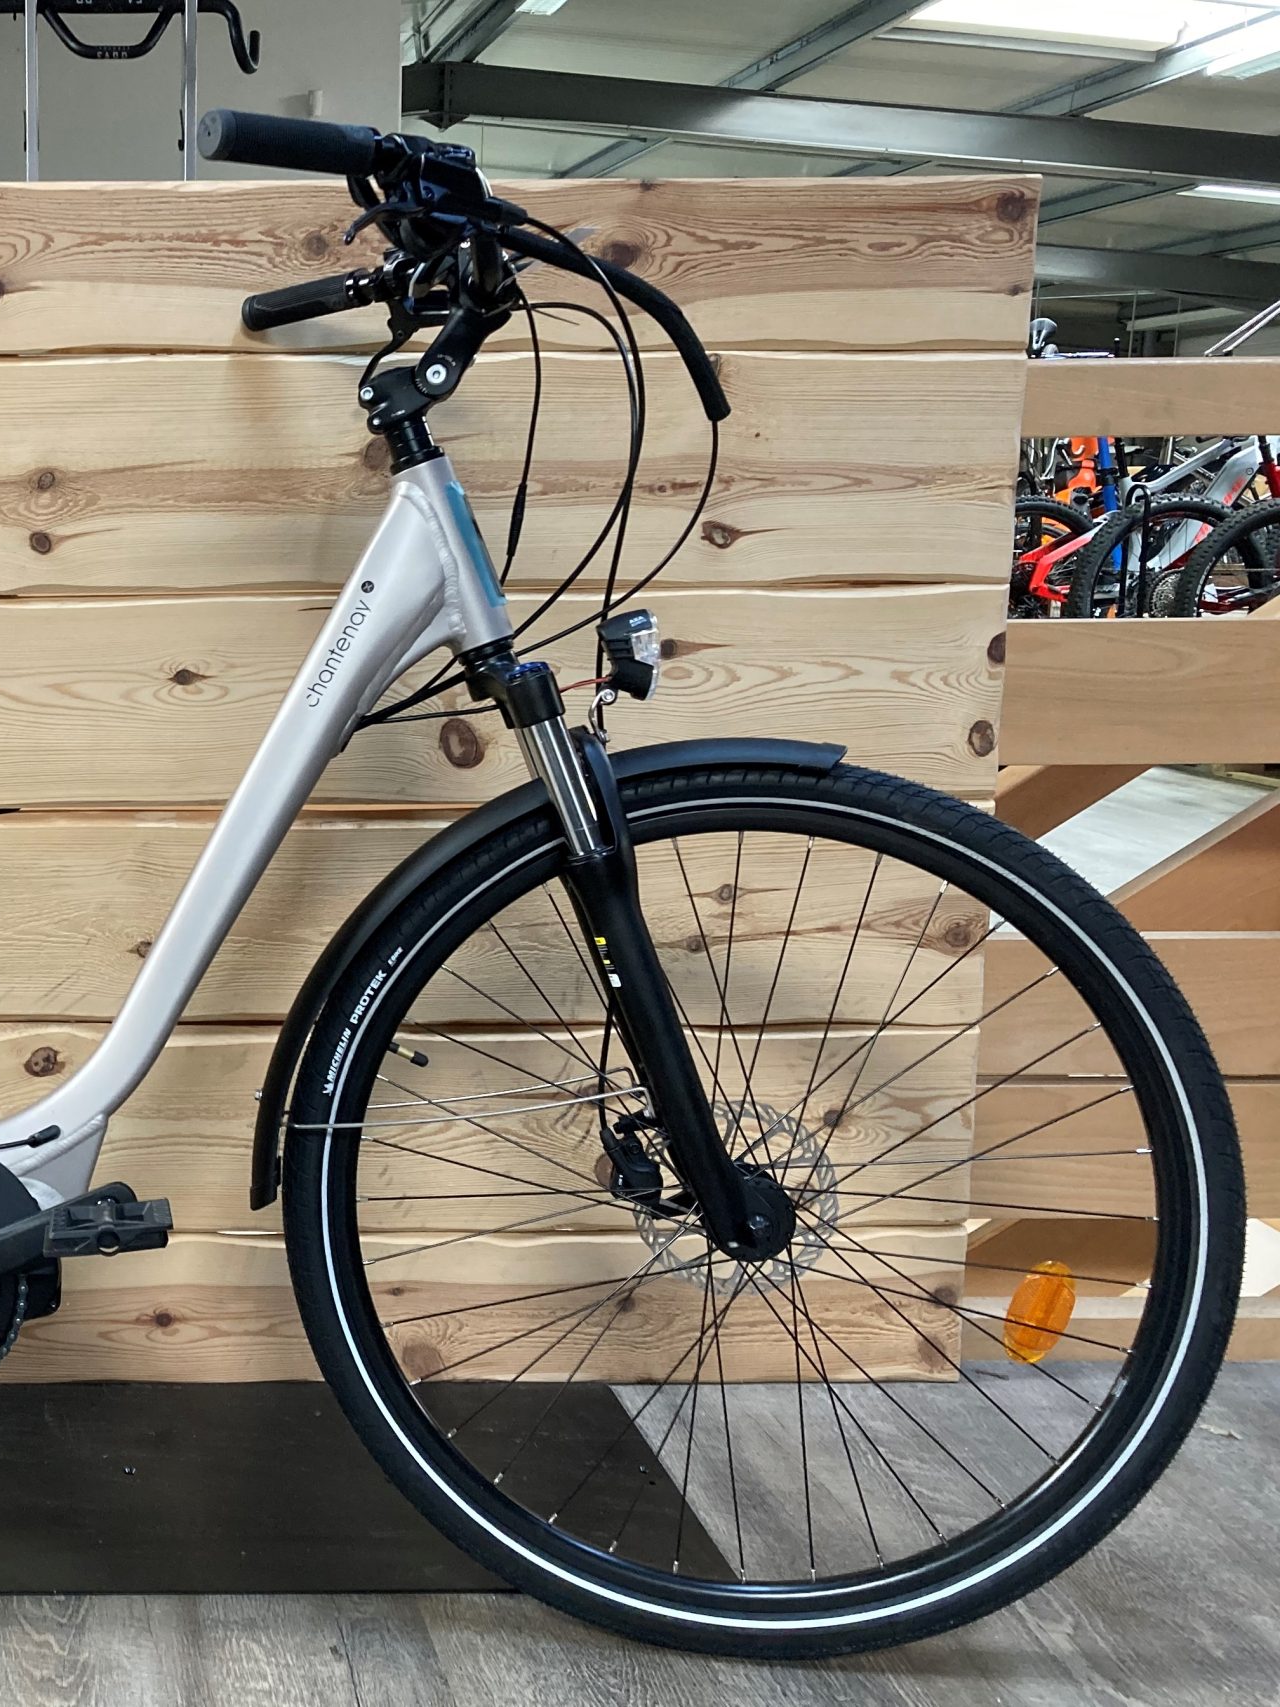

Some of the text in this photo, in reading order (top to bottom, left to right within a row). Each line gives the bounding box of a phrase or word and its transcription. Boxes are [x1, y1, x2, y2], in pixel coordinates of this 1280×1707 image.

[306, 598, 372, 708] chantenay
[327, 1027, 352, 1083] MICHELIN
[349, 969, 388, 1025] PROTEK
